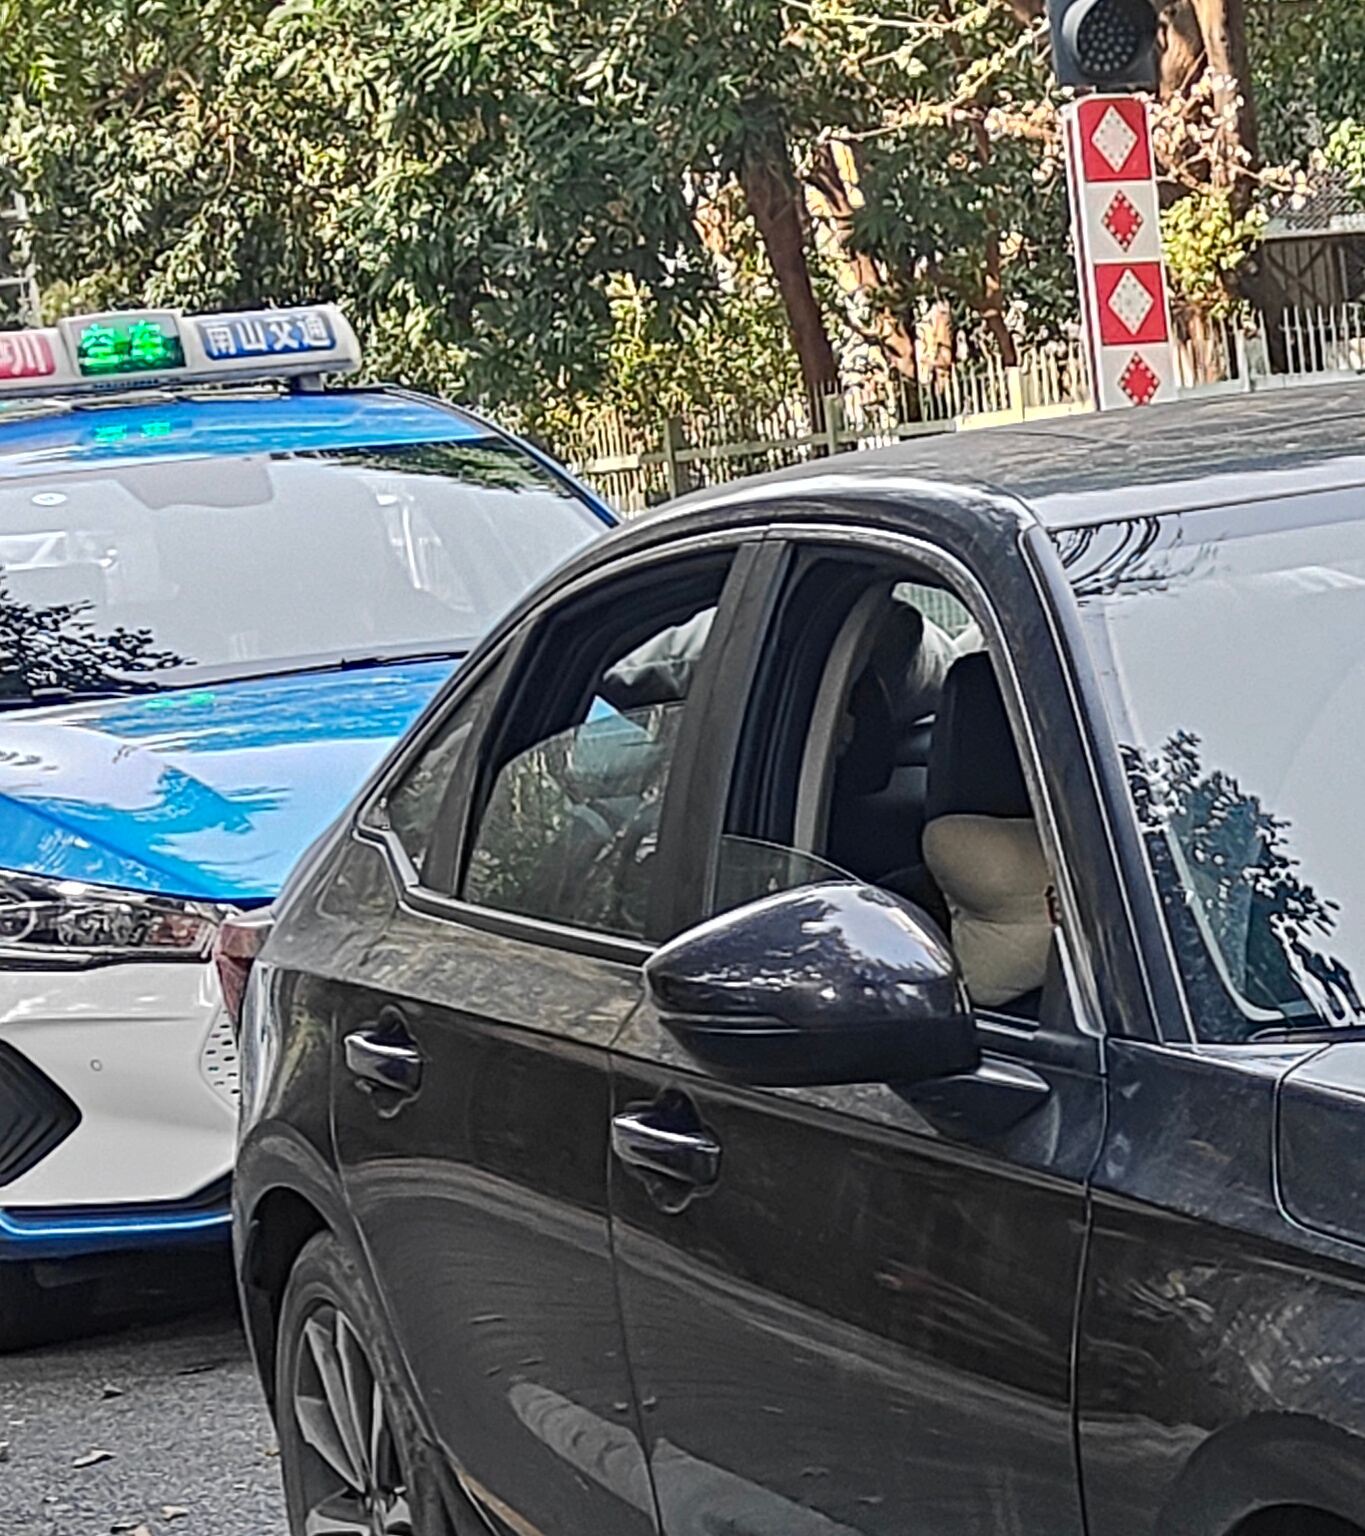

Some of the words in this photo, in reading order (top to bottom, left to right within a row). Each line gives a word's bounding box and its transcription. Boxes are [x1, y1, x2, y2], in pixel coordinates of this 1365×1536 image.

[81, 320, 161, 366] 空车
[202, 316, 332, 356] 南山交通
